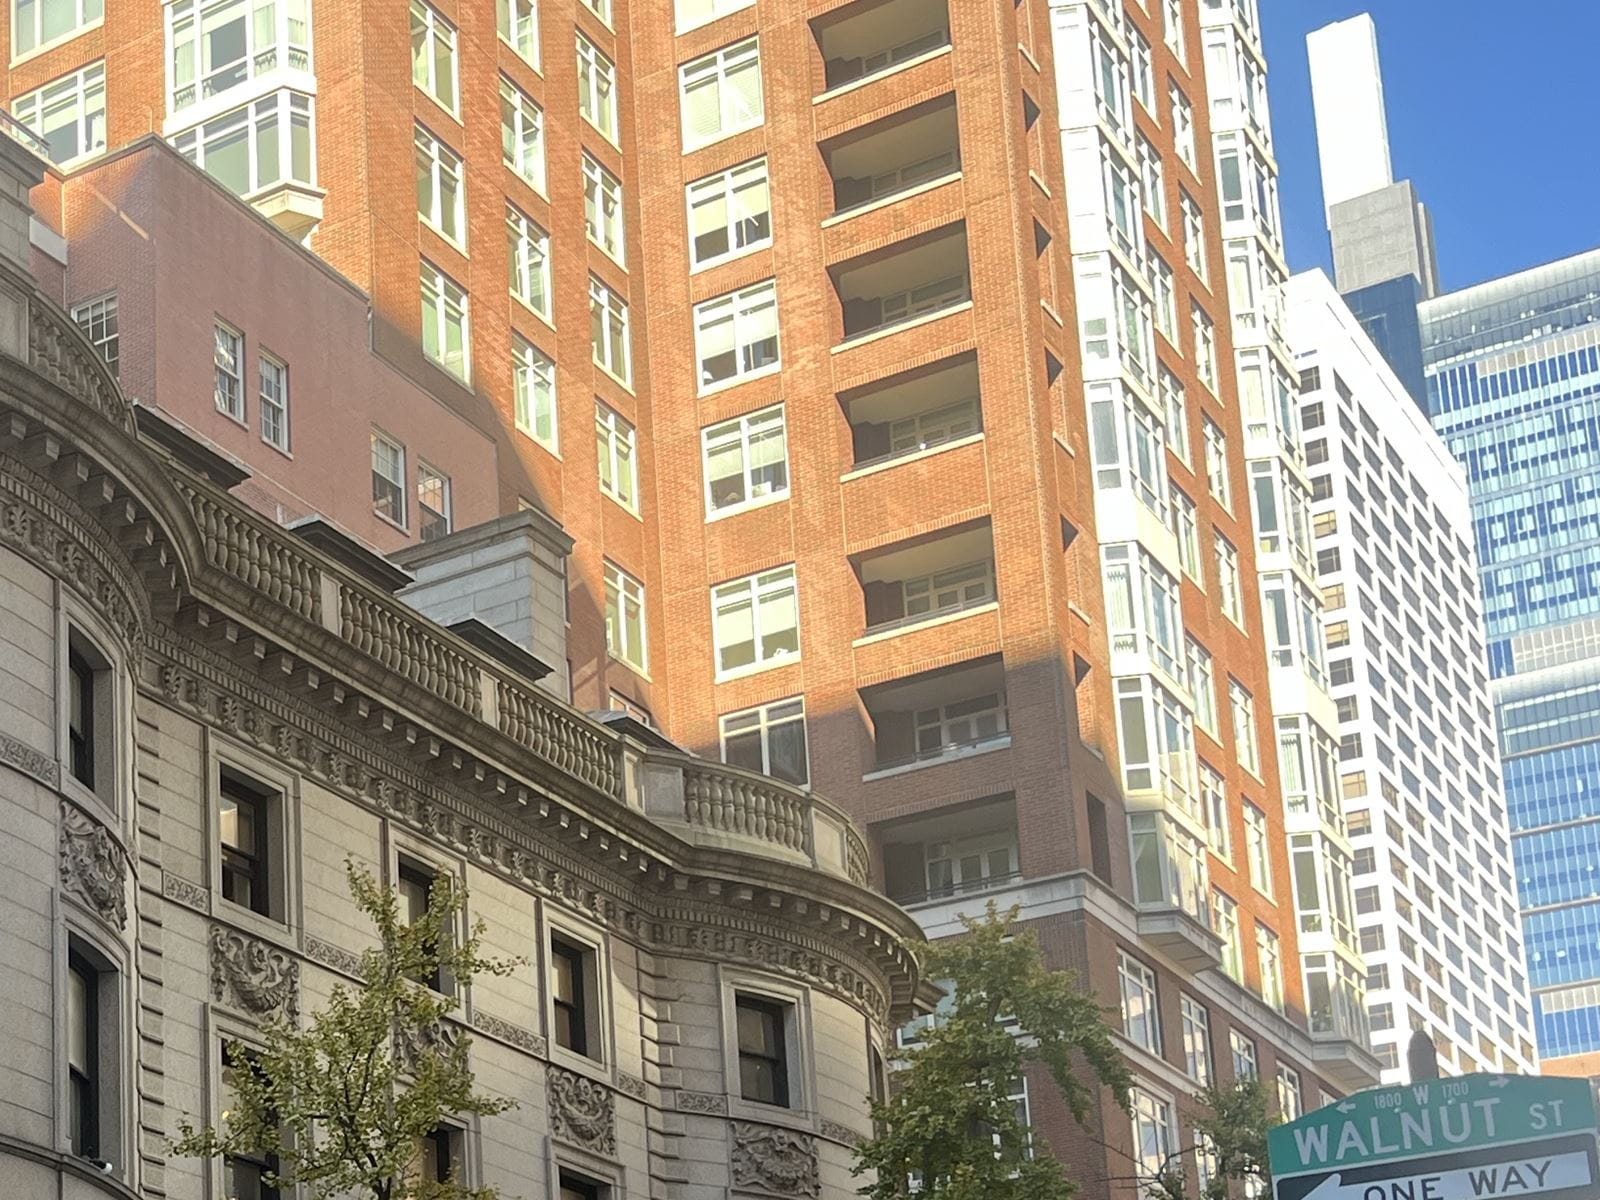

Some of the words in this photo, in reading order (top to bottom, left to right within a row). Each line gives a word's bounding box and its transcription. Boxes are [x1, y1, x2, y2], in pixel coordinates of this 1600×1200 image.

[1374, 1092, 1401, 1110] 1800
[1413, 1084, 1429, 1105] W
[1442, 1080, 1469, 1099] 1700
[1293, 1098, 1501, 1165] WALNUT
[1528, 1099, 1564, 1130] ST
[1468, 1159, 1553, 1196] WAY
